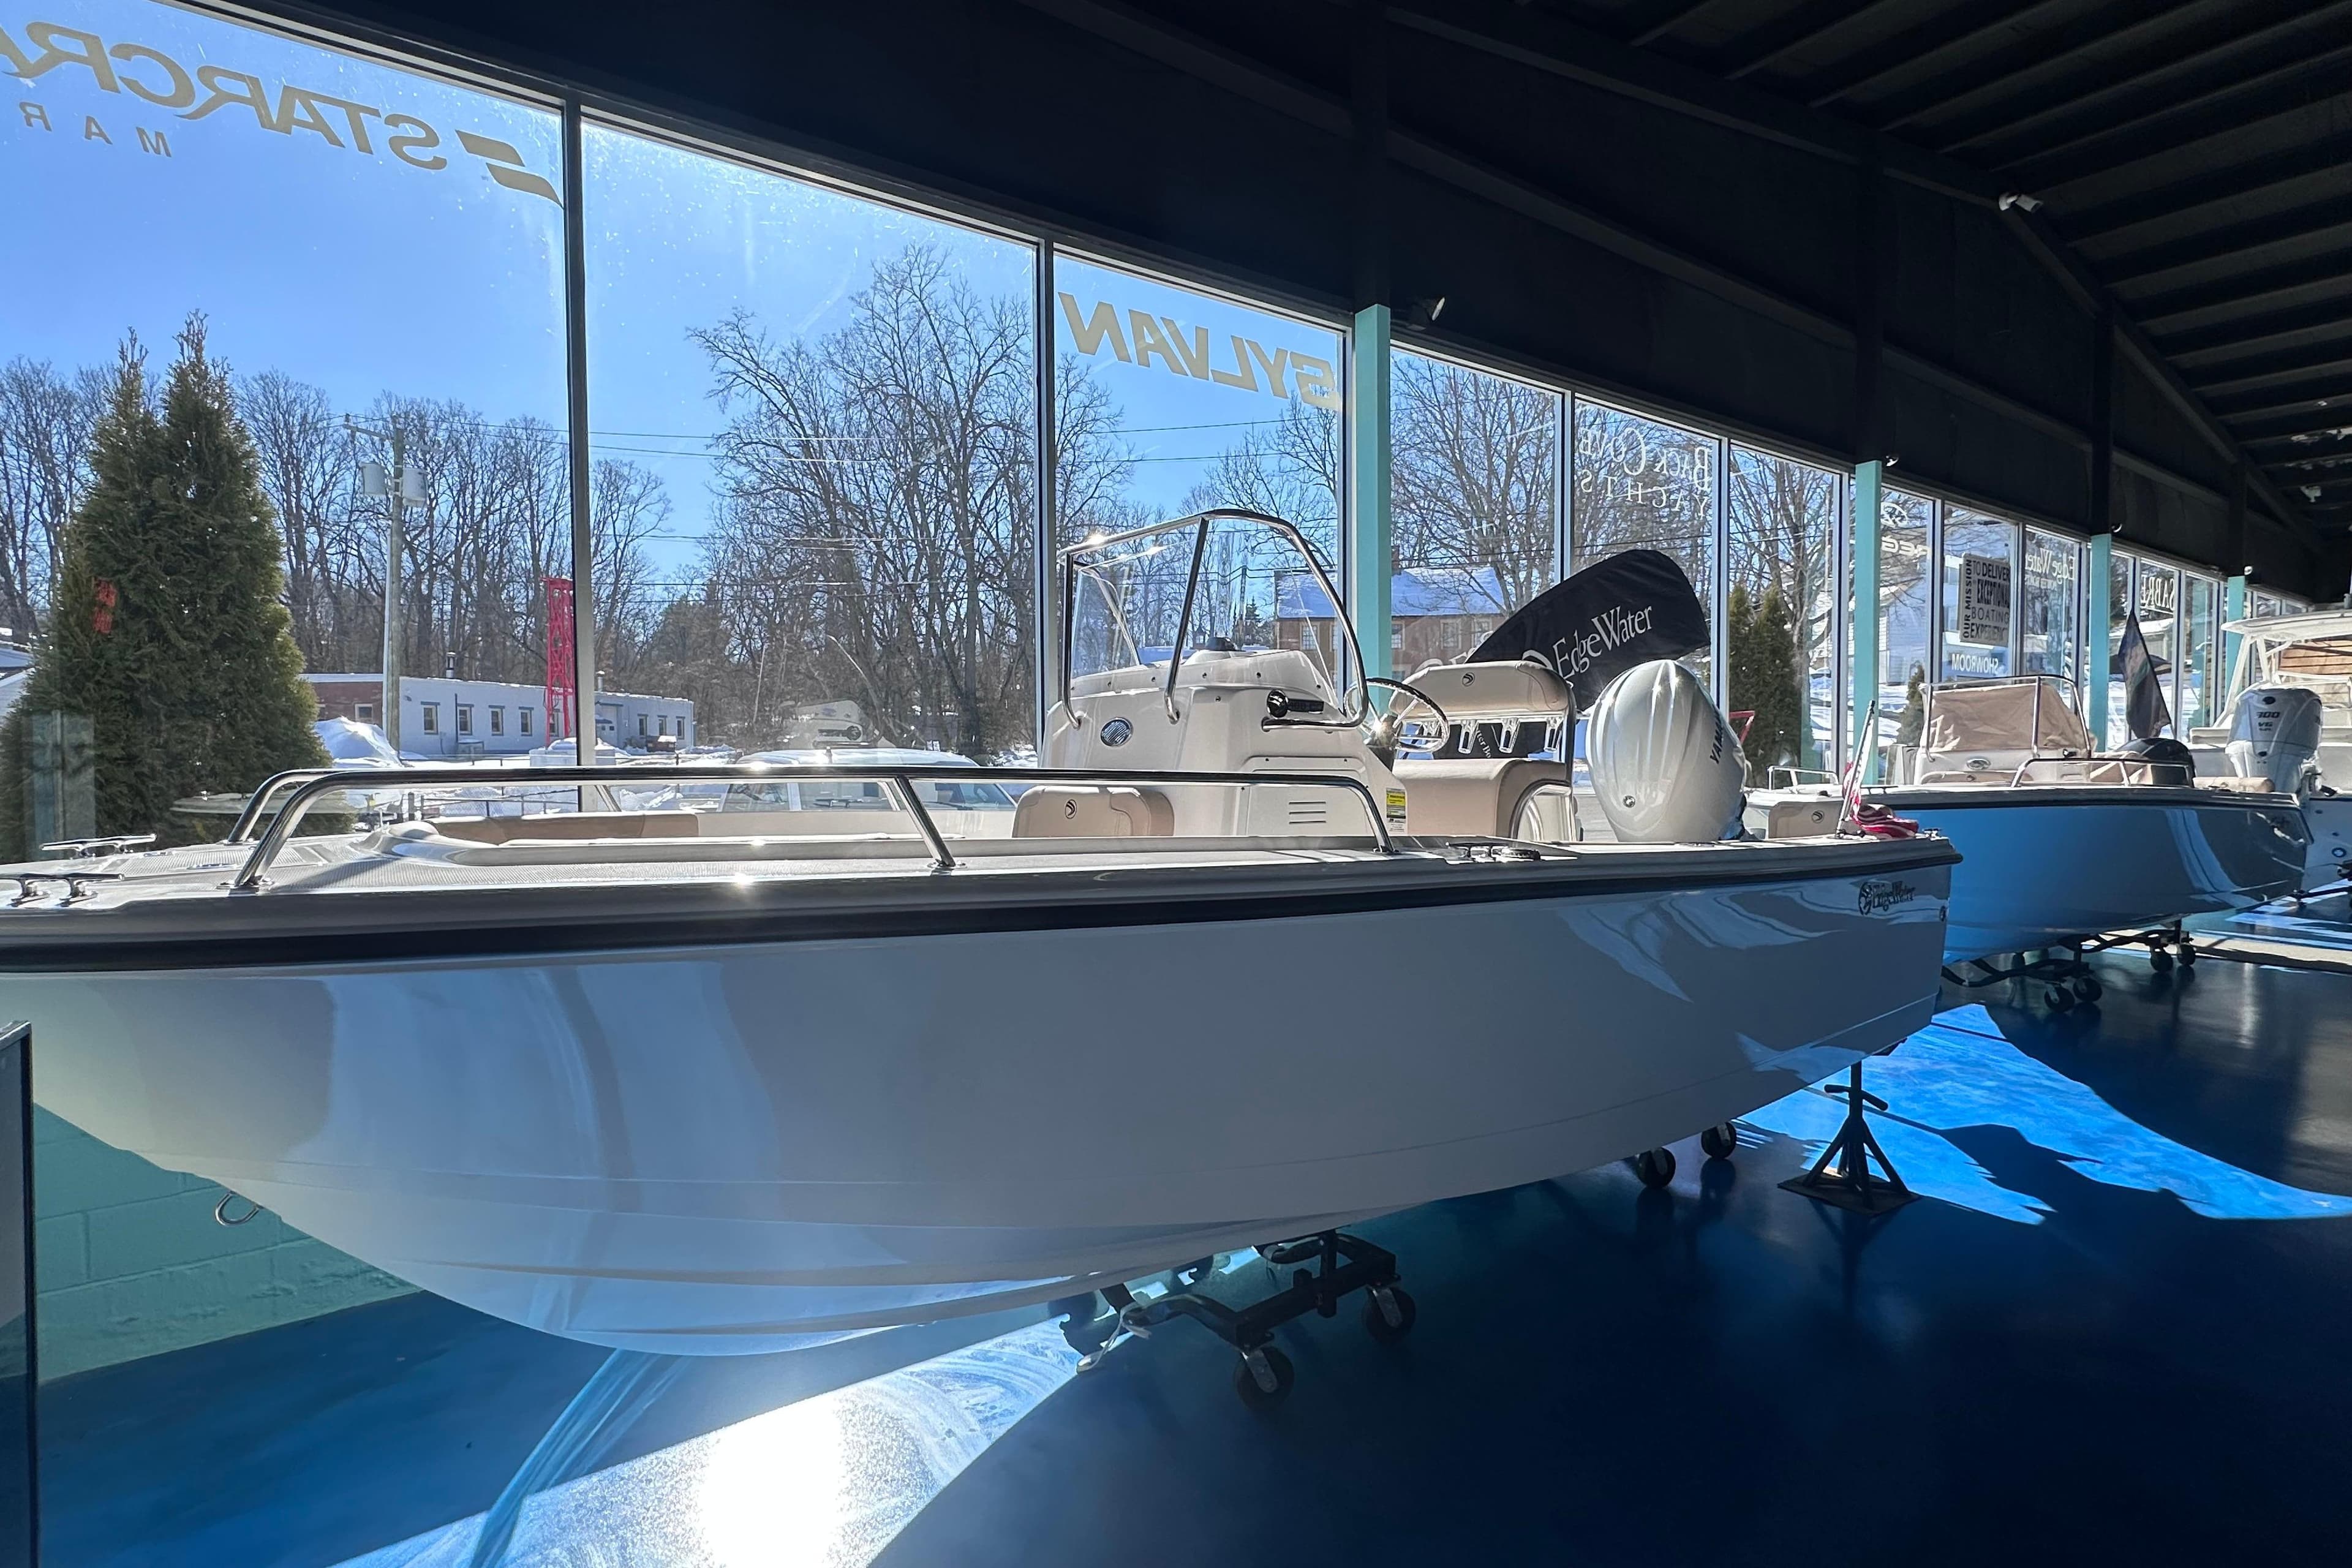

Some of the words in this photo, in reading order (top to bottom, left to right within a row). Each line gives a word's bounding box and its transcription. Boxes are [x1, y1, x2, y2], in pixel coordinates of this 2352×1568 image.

[1972, 560, 1981, 576] TO
[1982, 562, 2010, 582] DELIVER
[1962, 614, 1971, 638] OUR
[1971, 606, 2010, 624] BOATING
[1553, 605, 1653, 680] EdgeWater
